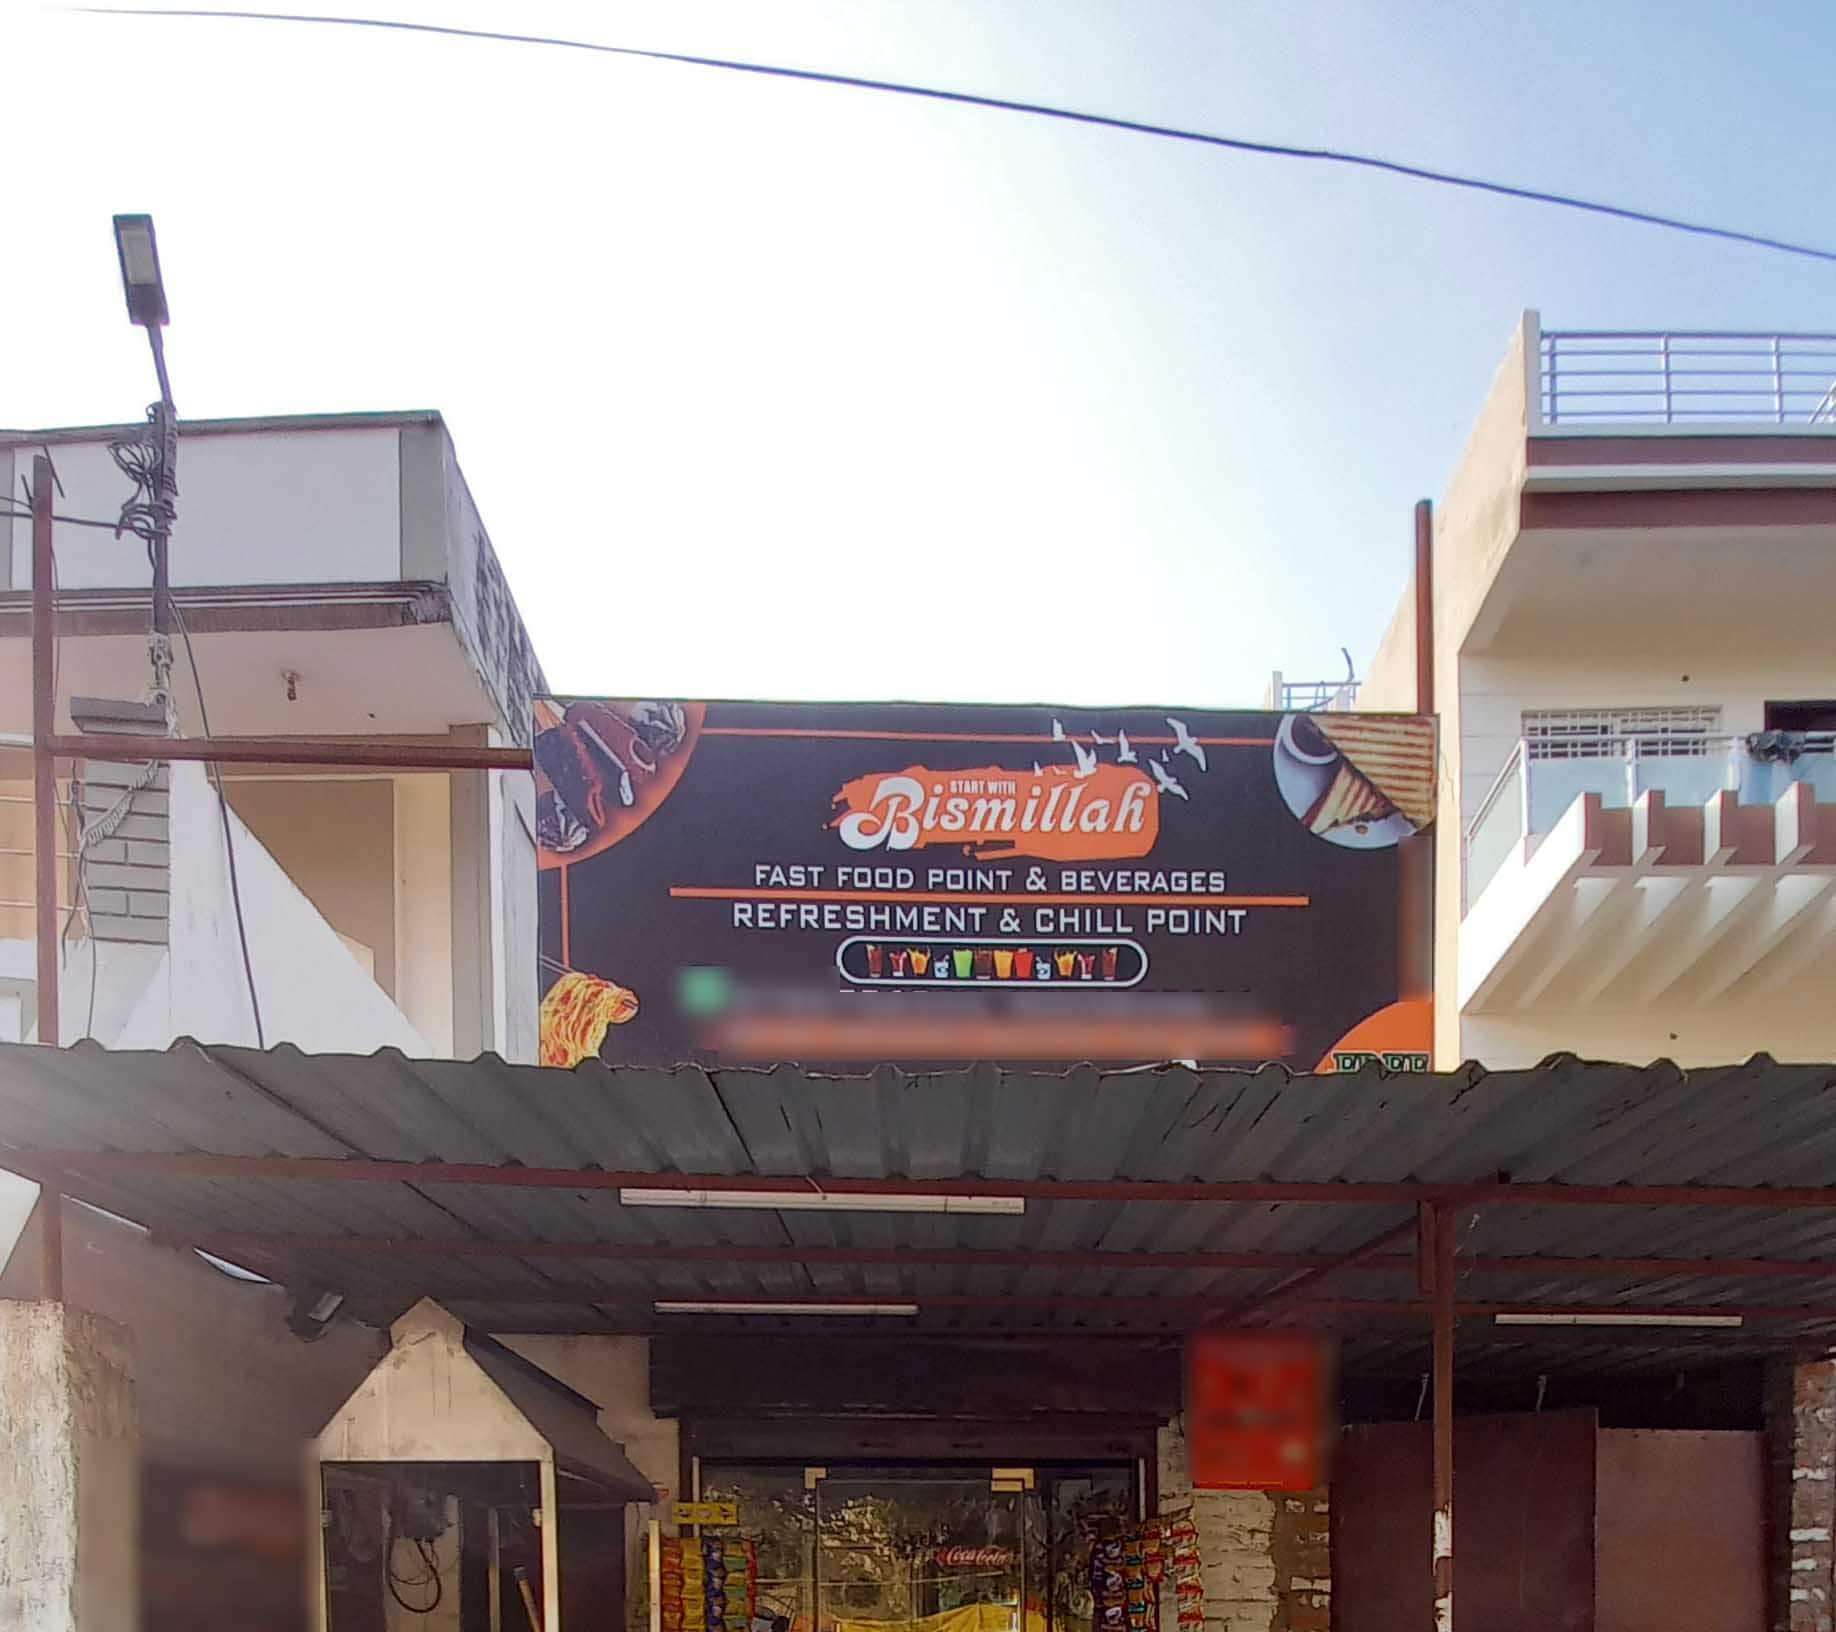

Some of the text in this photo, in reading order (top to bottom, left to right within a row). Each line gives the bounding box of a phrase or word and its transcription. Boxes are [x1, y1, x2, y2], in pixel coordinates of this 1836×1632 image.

[949, 780, 1017, 795] START WITH
[839, 776, 1151, 851] Bismillah
[755, 864, 1226, 893] FAST FOOD POINT & BEVERAGES
[732, 902, 1247, 934] REFRESHMENT & CHILL POINT
